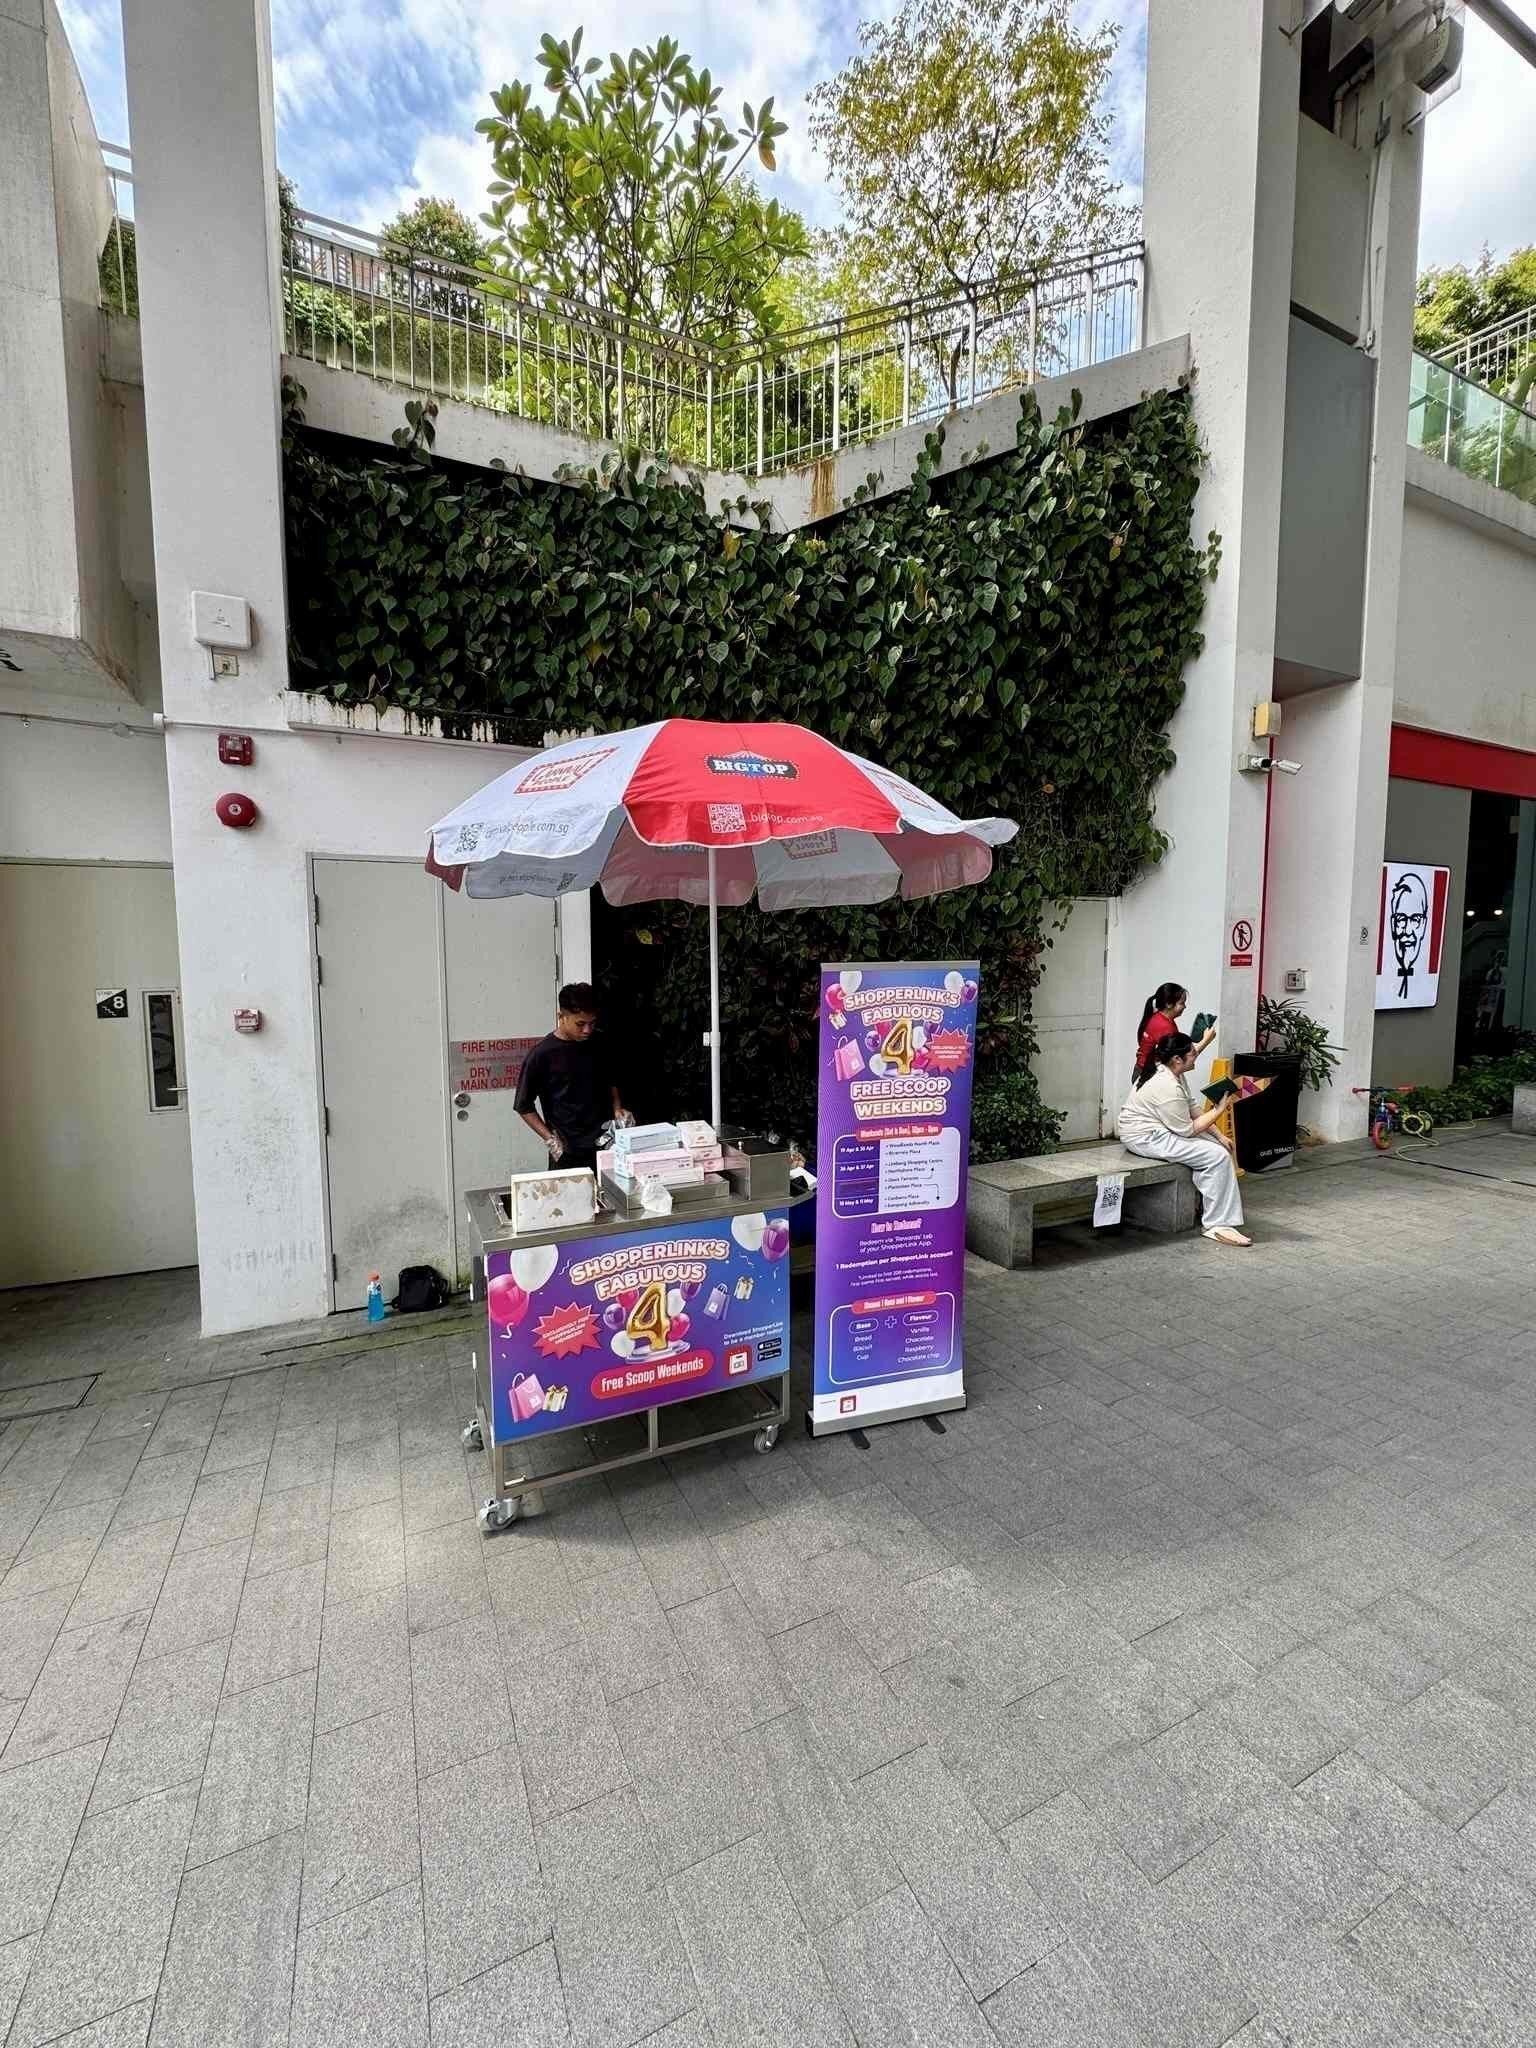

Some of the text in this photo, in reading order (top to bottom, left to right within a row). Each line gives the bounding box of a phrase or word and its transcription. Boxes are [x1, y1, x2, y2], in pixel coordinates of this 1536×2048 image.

[713, 758, 788, 775] BIGTOP
[113, 996, 125, 1009] 8
[844, 987, 961, 1011] SHOPPERLINK'S
[863, 1005, 943, 1025] FABULOUS
[462, 1041, 485, 1053] FIRE
[488, 1040, 517, 1051] HOSE
[881, 1019, 914, 1075] 4
[470, 1067, 491, 1079] DRY
[461, 1080, 488, 1091] MAIN
[852, 1078, 951, 1098] FREE SCOOP
[855, 1099, 945, 1119] WEEKENDS
[570, 1239, 730, 1285] SHOPPERLINK'S
[840, 1259, 879, 1269] Redemption
[890, 1253, 929, 1263] ShopperLink
[596, 1263, 706, 1300] FABULOUS
[626, 1281, 671, 1353] 4
[625, 1369, 655, 1391] Scoop
[655, 1357, 704, 1381] Weekends
